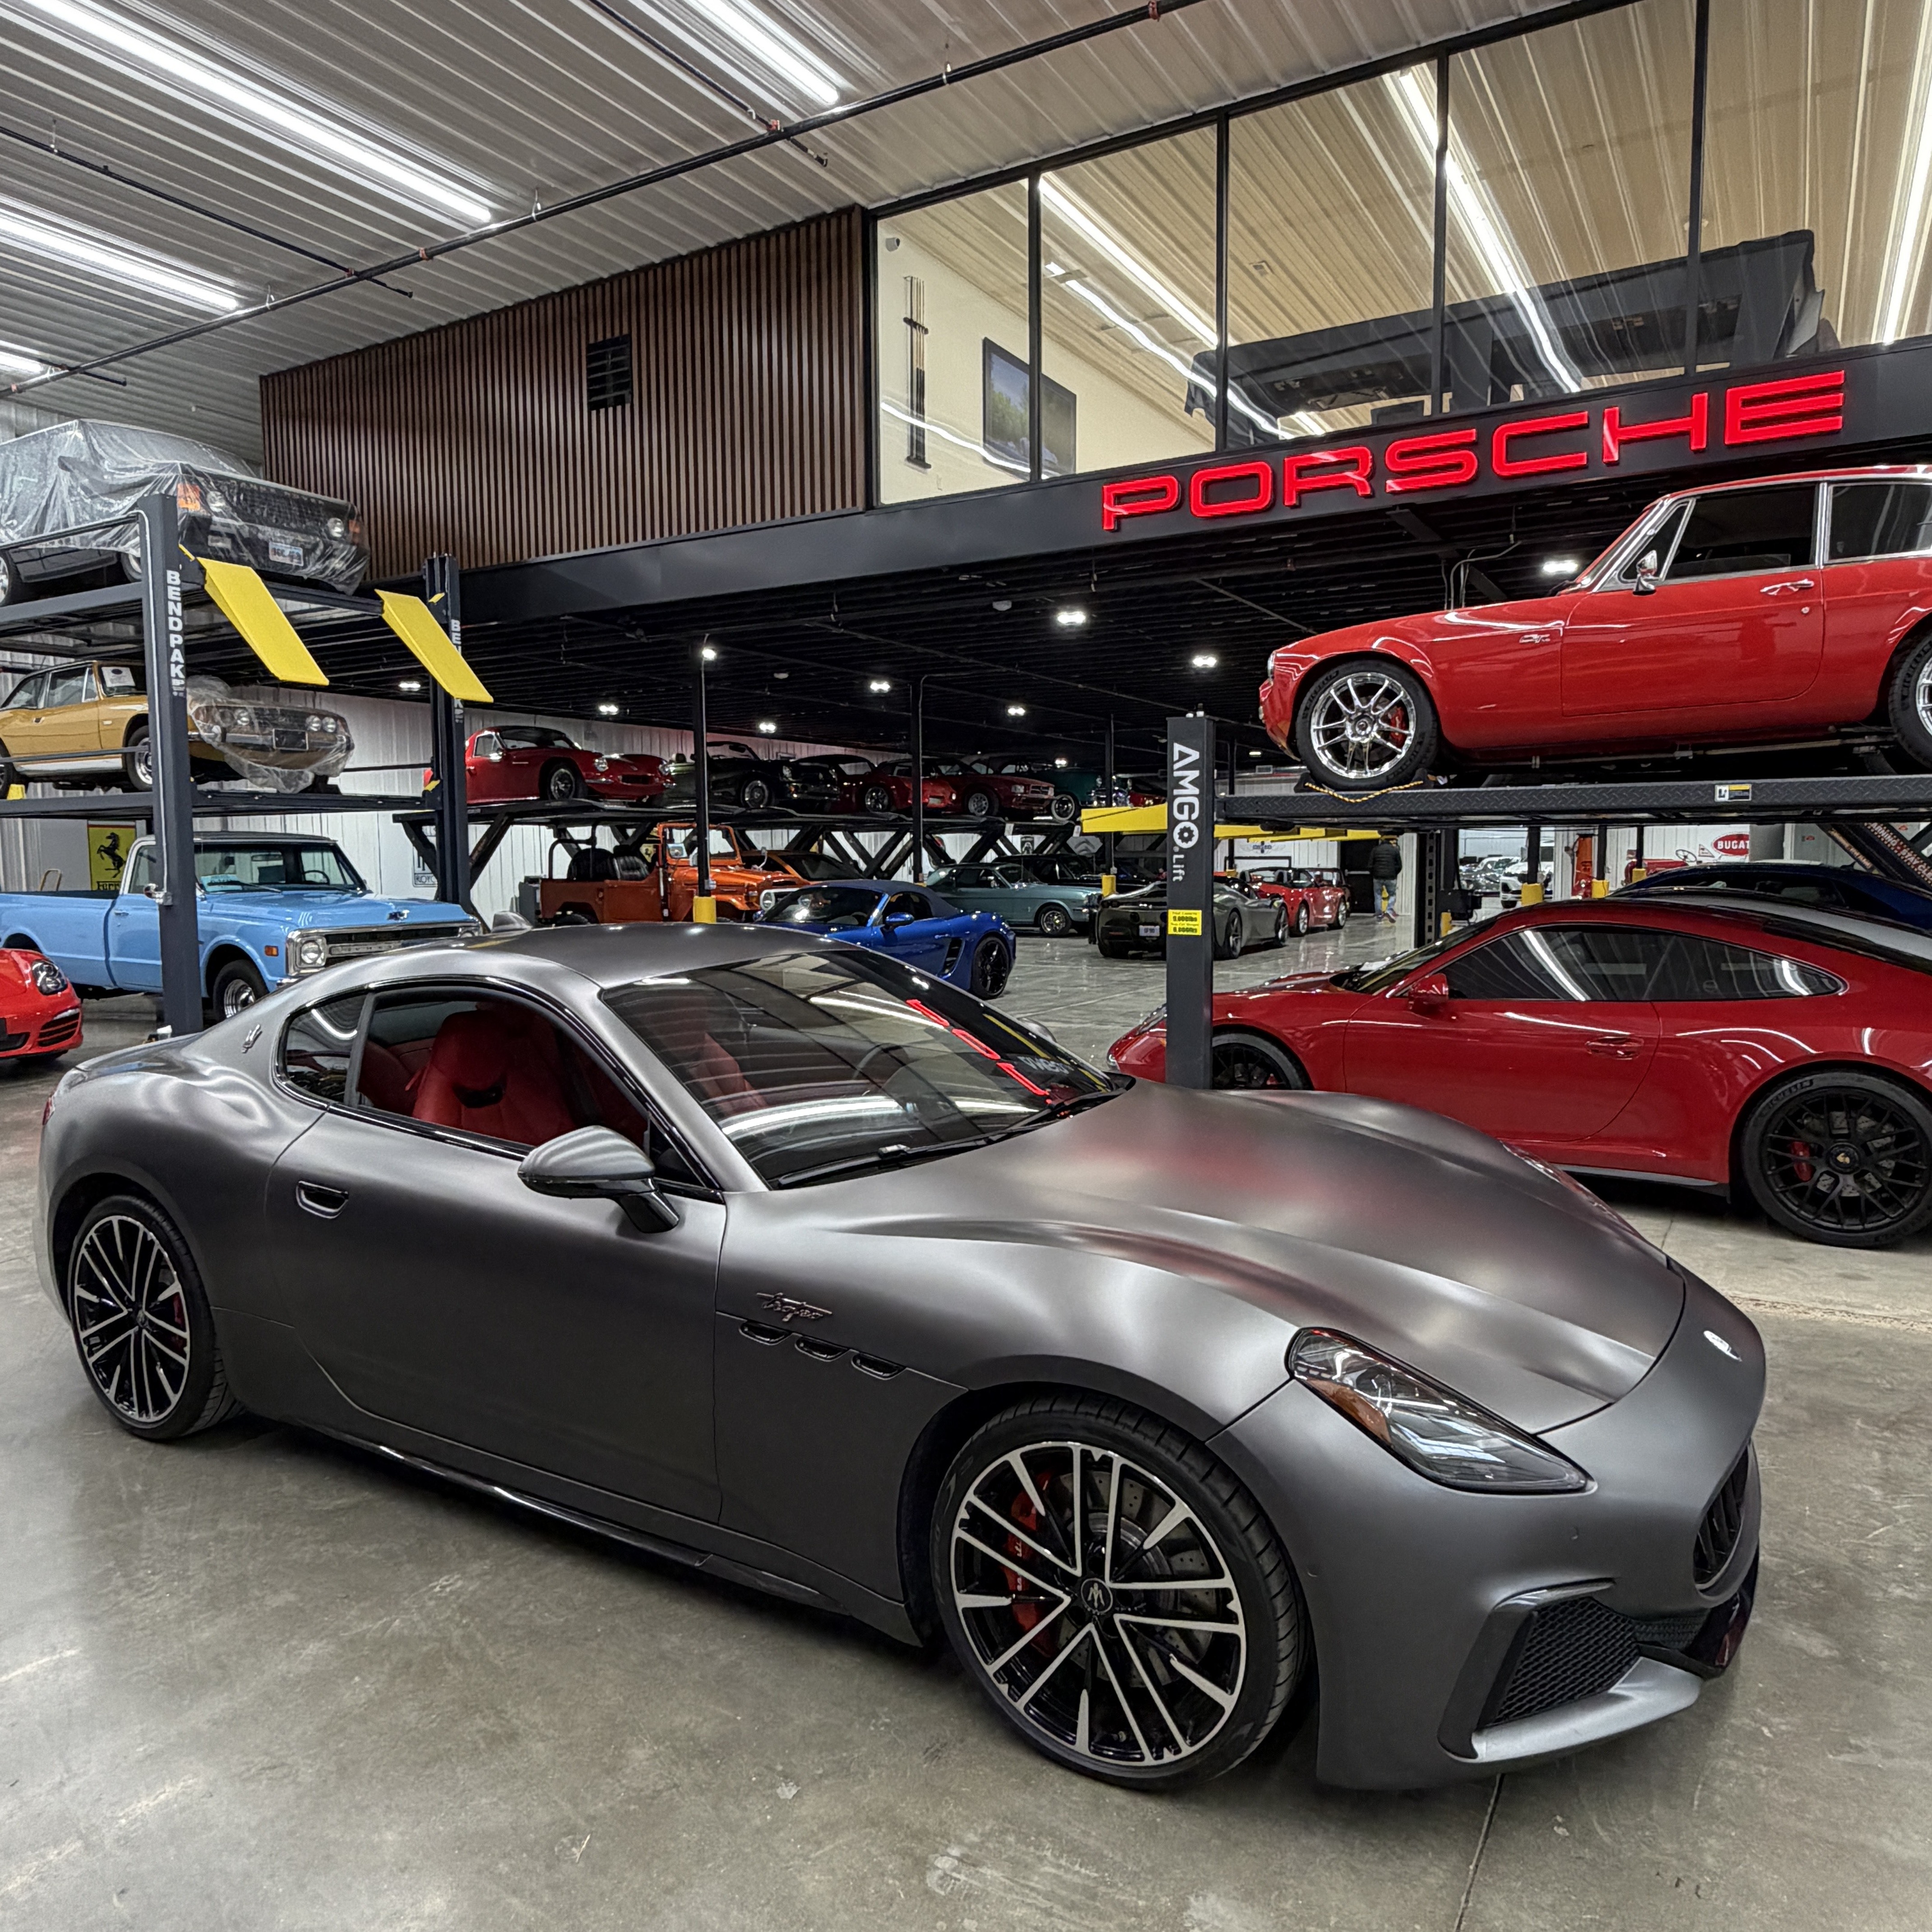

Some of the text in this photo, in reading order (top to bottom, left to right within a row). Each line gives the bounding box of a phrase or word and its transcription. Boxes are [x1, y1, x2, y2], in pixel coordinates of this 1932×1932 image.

[1102, 370, 1845, 531] PORSCHE
[166, 570, 185, 678] BENDPAK
[1870, 823, 1897, 846] ARNING
